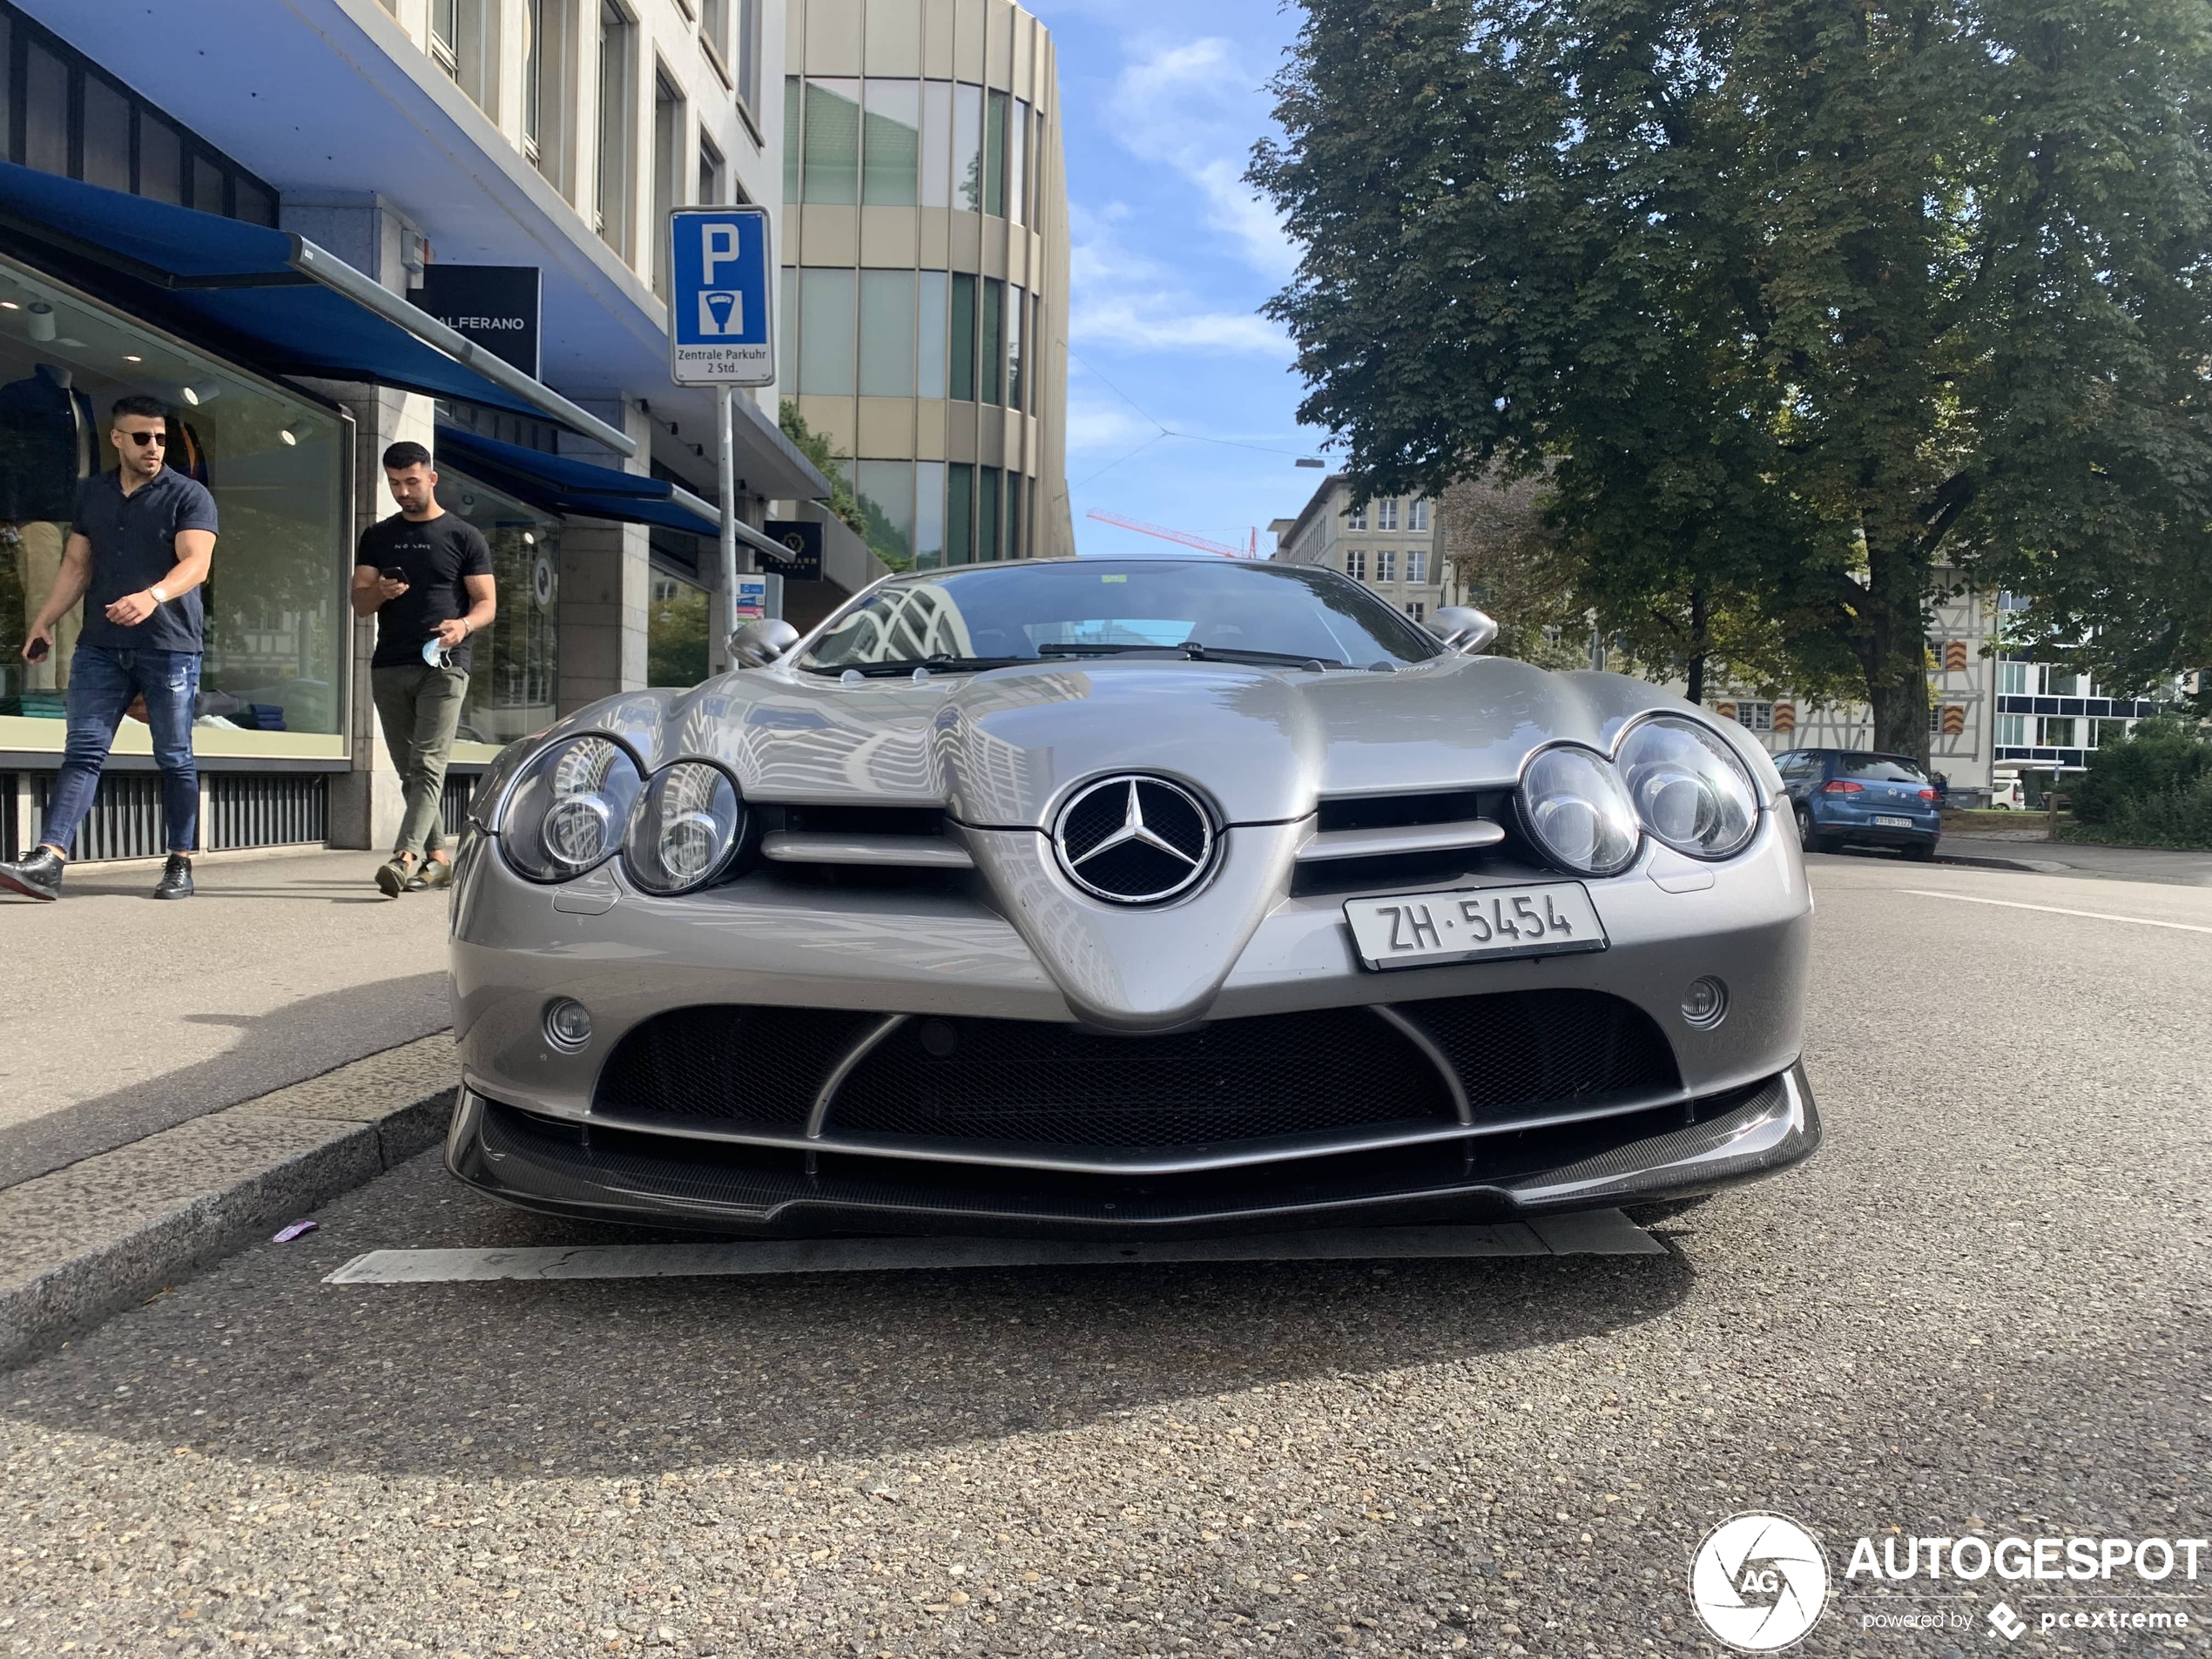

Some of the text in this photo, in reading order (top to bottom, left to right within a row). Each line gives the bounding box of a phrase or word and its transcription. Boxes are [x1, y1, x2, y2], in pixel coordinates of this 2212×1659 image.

[702, 223, 739, 285] P
[678, 349, 766, 361] Zentrale Parkuhr
[707, 362, 738, 374] 2 Std.
